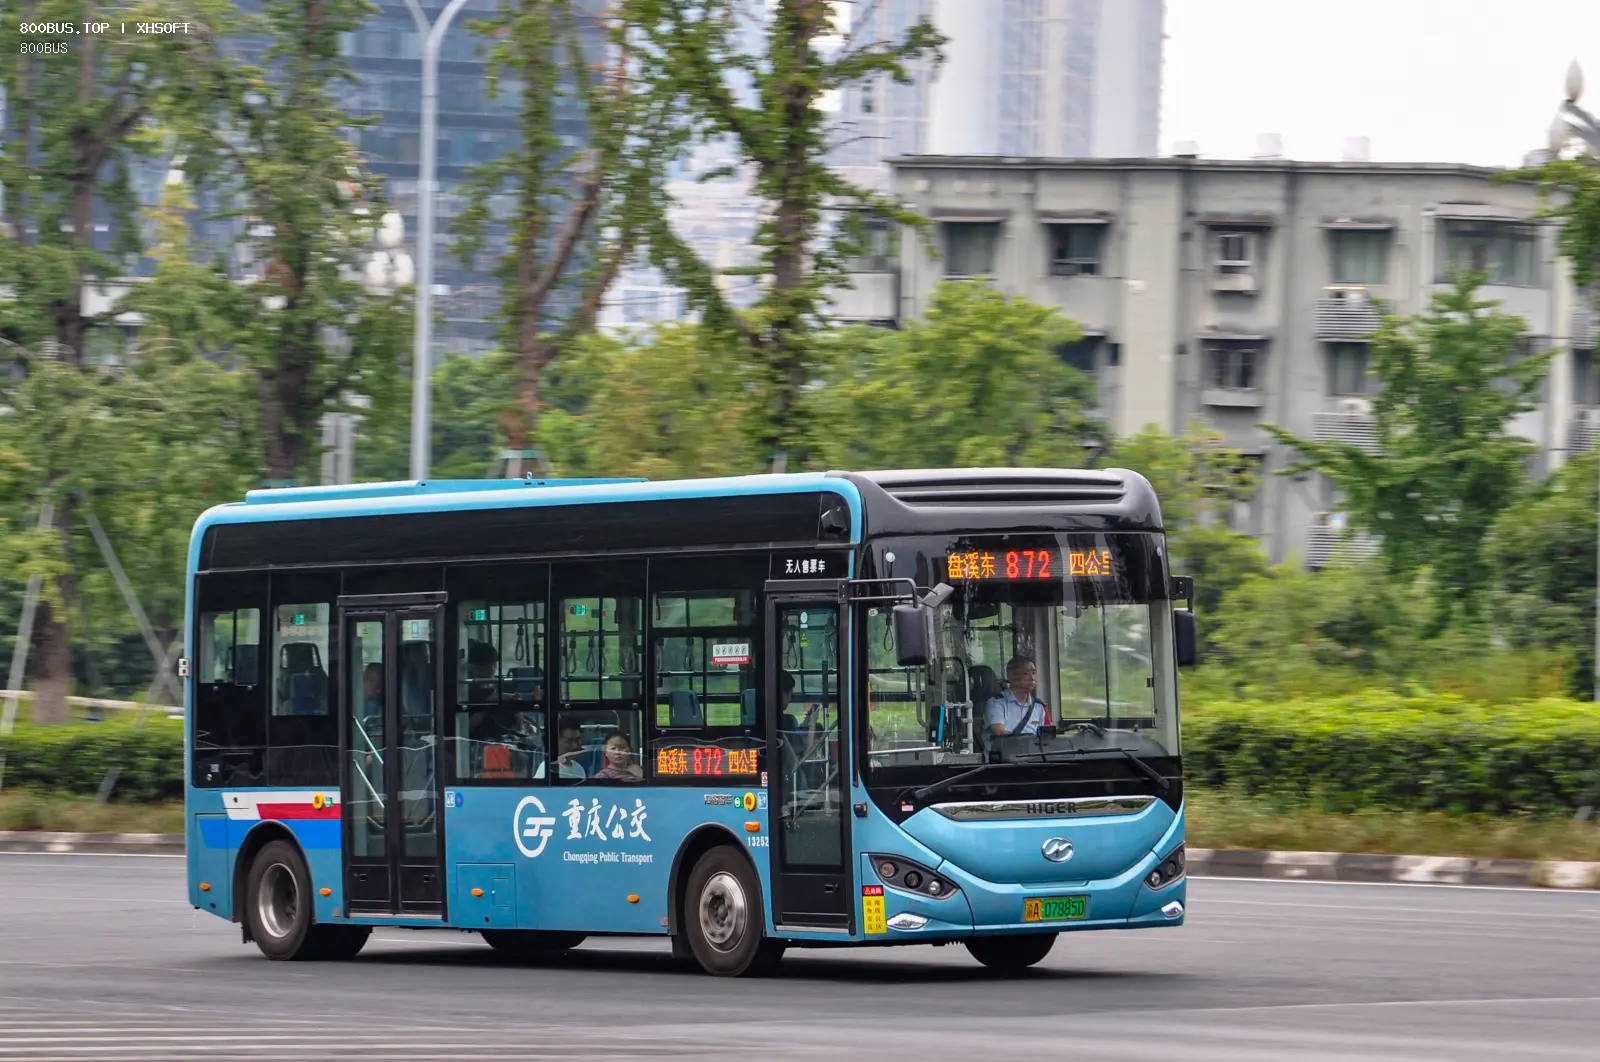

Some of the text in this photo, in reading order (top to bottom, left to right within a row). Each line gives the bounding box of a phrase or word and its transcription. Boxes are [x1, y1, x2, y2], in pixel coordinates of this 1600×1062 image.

[948, 551, 995, 579] 盘溪东
[1006, 550, 1051, 579] 872
[658, 747, 758, 776] 盘溪东 872 四公里
[1026, 802, 1077, 814] HIGER
[562, 798, 652, 842] 重庆公交
[747, 836, 769, 847] 13252
[563, 851, 653, 865] Chongqing Public Transport
